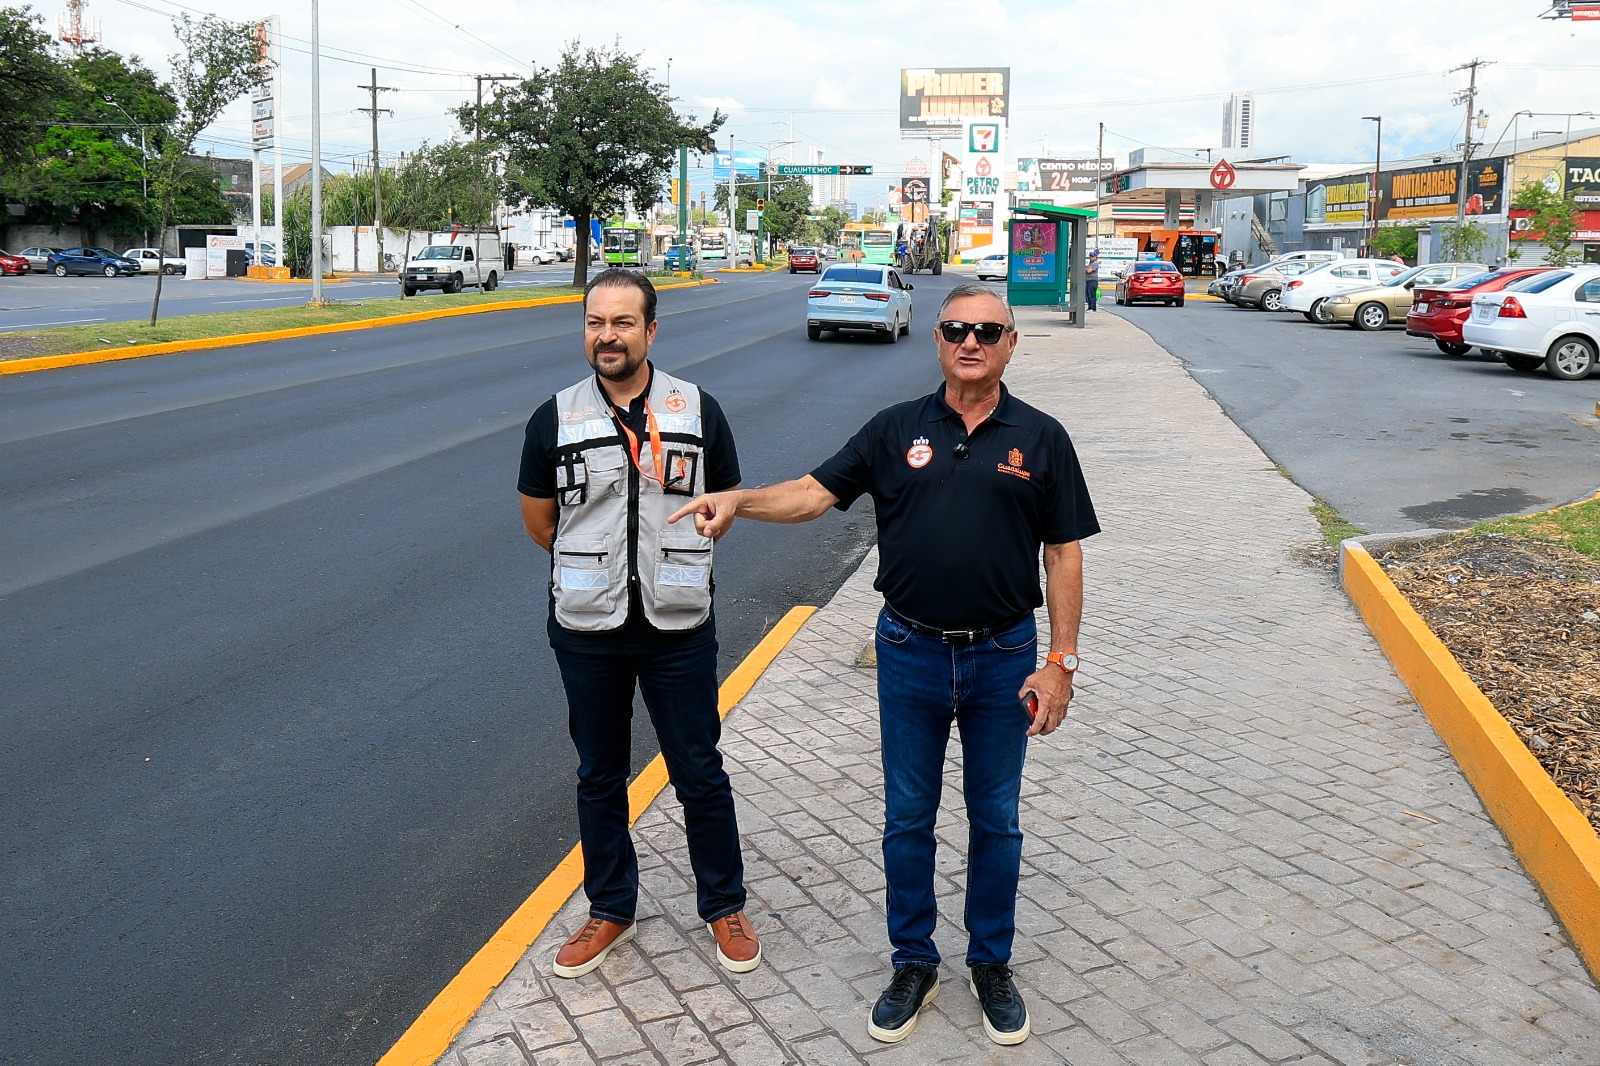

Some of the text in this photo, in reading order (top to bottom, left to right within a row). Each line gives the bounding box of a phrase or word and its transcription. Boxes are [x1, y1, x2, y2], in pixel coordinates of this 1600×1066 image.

[907, 72, 1004, 96] PRIMER
[920, 96, 990, 117] LUGAR
[977, 130, 992, 150] 7
[783, 166, 833, 174] CUAUHTEMOC
[1077, 161, 1113, 171] MÉDICO
[967, 177, 999, 187] PETRO
[1051, 172, 1070, 190] 24
[1216, 171, 1229, 188] 7
[1392, 169, 1457, 199] MONTACARGAS
[1479, 173, 1498, 182] TAGAR
[969, 186, 997, 195] SEVEN
[997, 463, 1031, 477] Guadalupe
